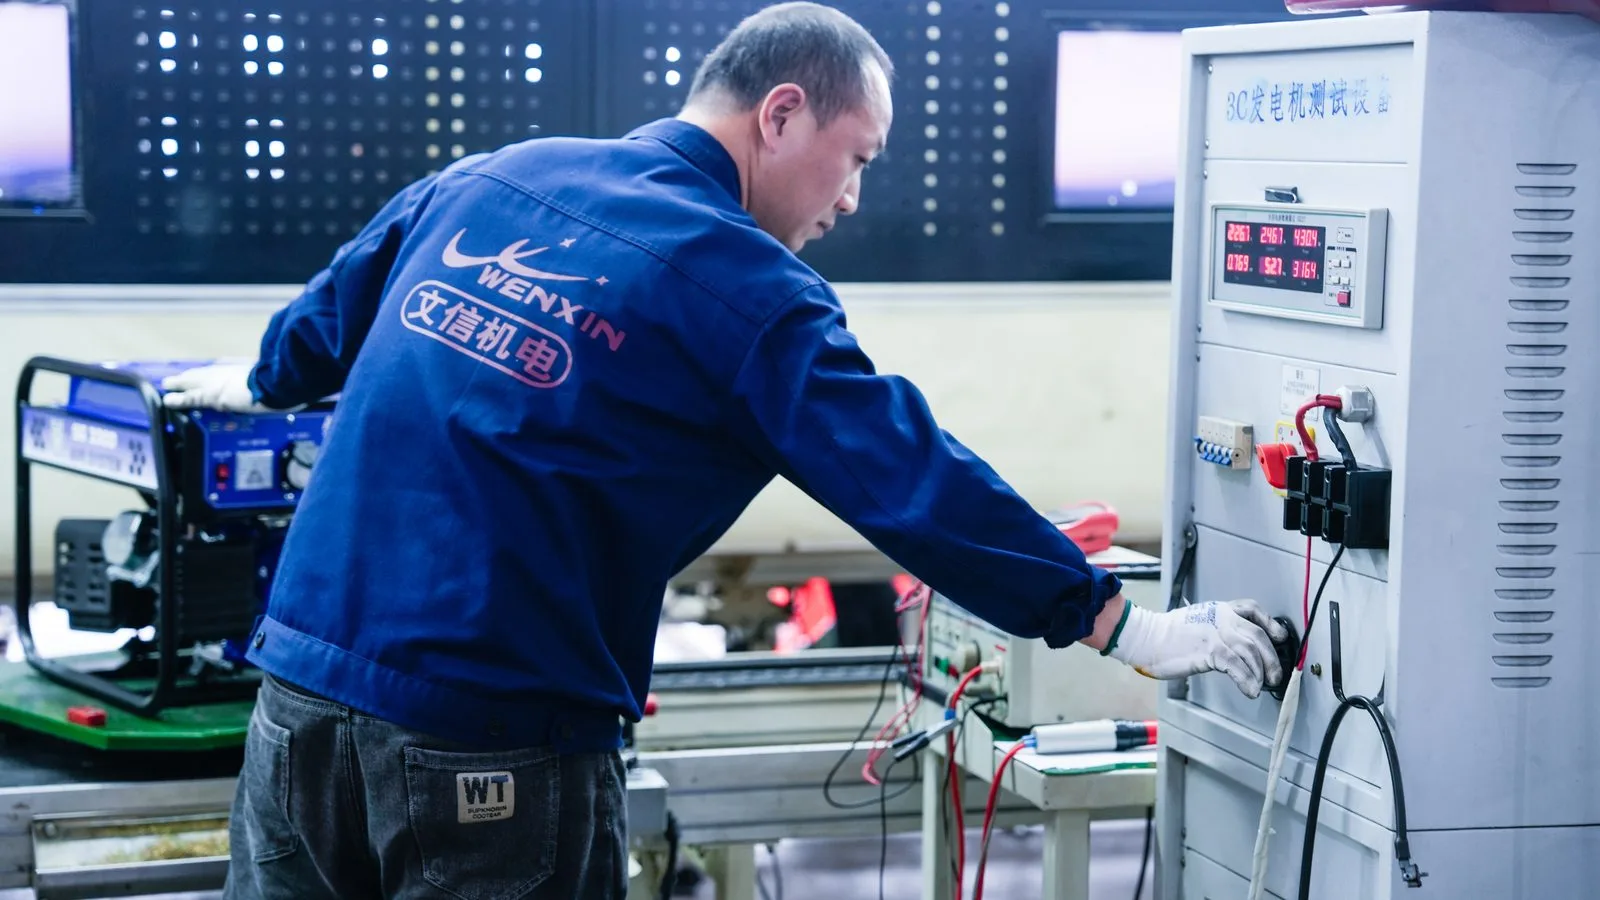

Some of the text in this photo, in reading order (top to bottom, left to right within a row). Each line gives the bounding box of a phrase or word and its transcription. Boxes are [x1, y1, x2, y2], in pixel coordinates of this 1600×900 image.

[407, 289, 559, 382] 文信机电
[476, 264, 627, 352] WENXIN
[462, 775, 509, 805] WT
